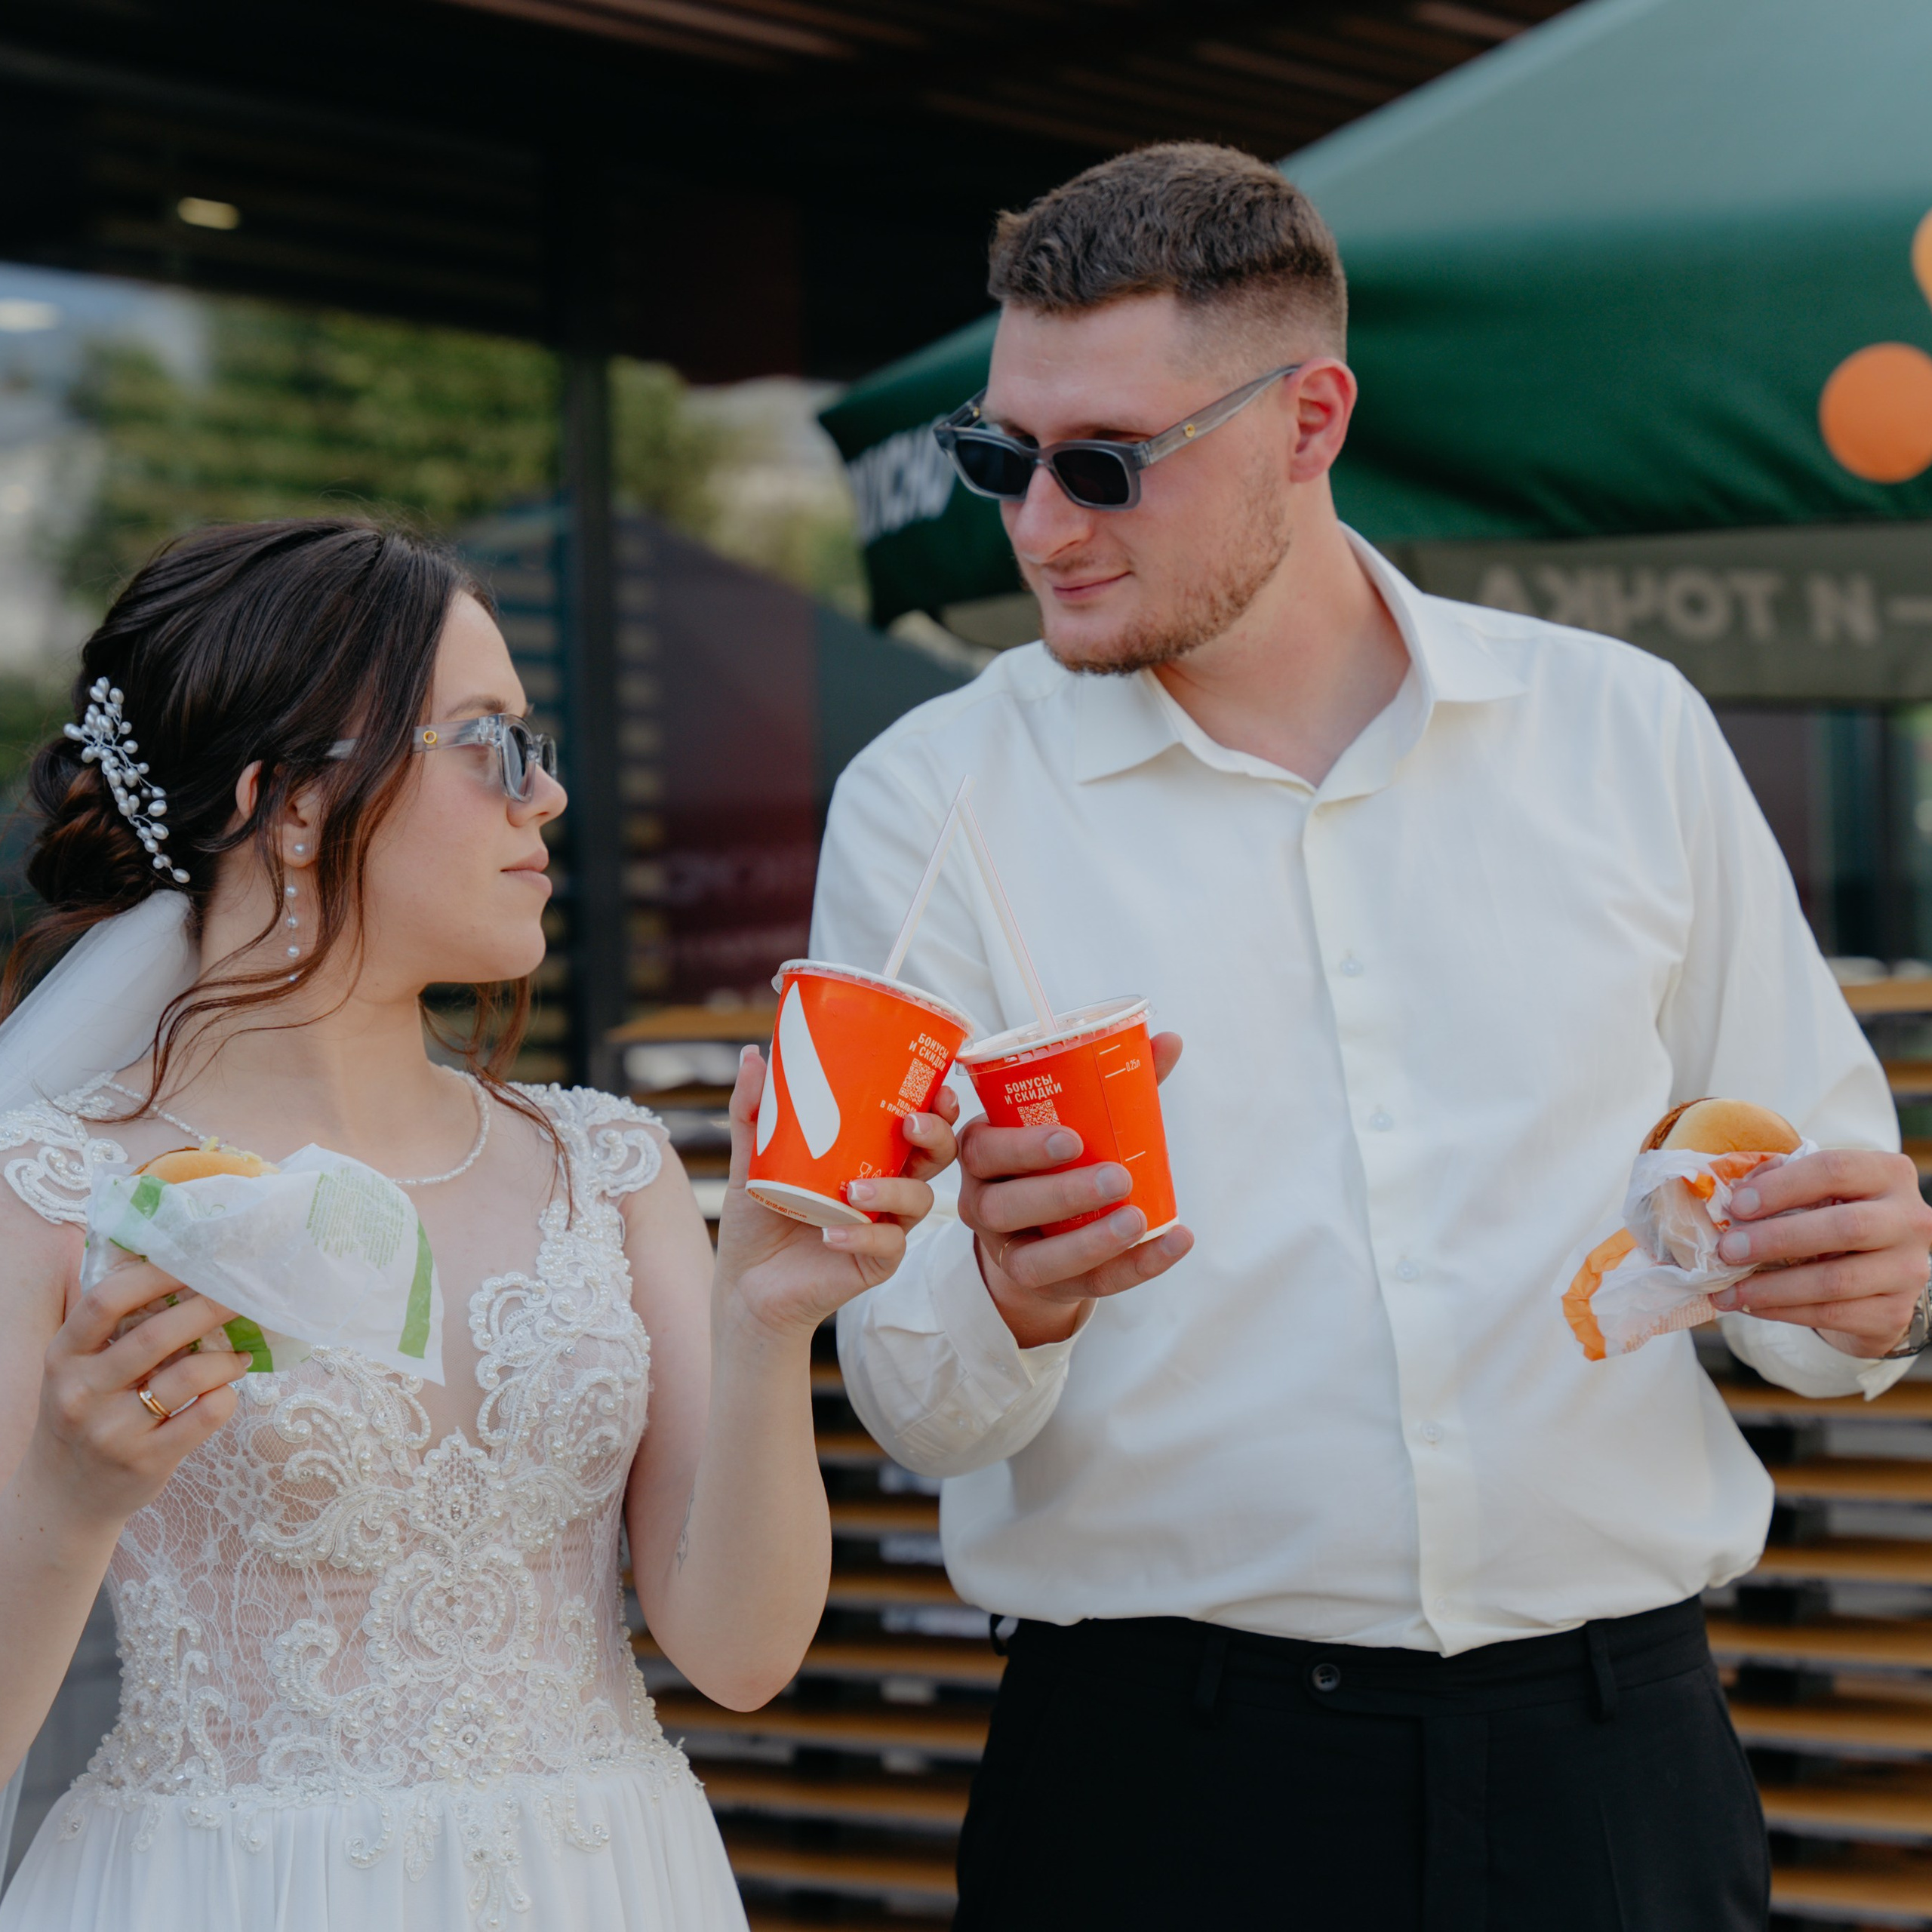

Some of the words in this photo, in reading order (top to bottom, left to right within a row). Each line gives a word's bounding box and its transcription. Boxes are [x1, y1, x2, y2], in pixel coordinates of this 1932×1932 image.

[908, 1041, 918, 1052] И
[918, 1046, 946, 1072] СКИДКИ
[918, 1032, 949, 1060] БОНУСЫ
[1004, 1074, 1054, 1094] БОНУСЫ
[1004, 1095, 1013, 1105] И
[1015, 1082, 1063, 1103] СКИДКИ
[880, 1100, 886, 1109] В
[886, 1103, 907, 1119] ПРИЛО
